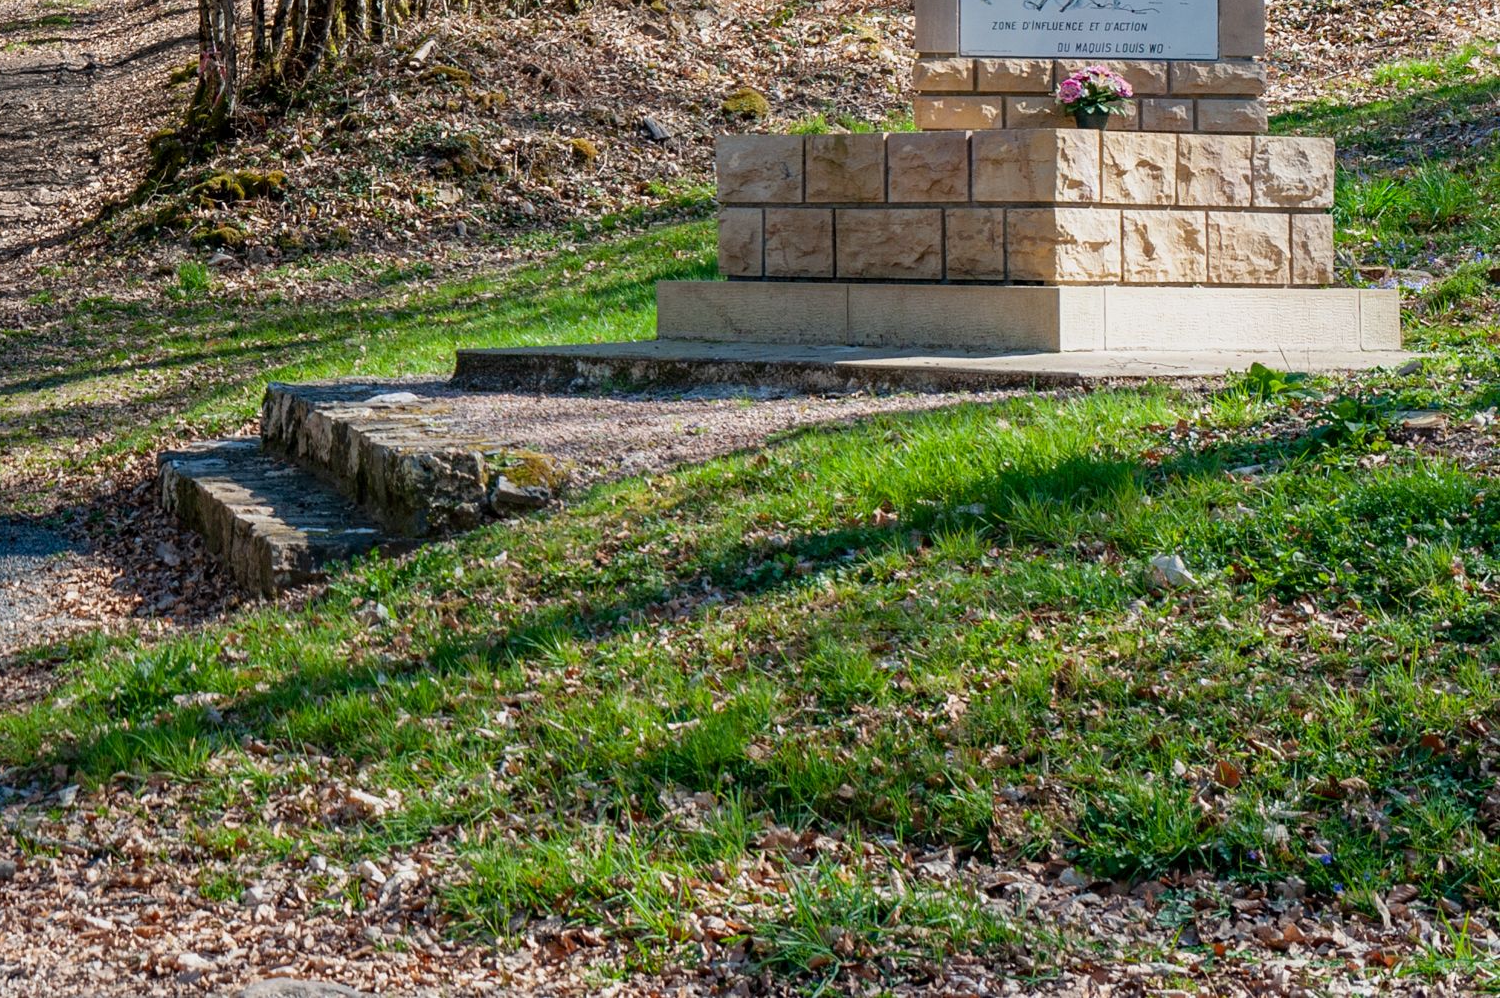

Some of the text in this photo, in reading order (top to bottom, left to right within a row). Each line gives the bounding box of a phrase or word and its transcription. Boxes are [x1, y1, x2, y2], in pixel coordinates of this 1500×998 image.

[992, 20, 1148, 32] ZONE D'INFLUENCE ET D'ACTION
[1057, 42, 1070, 52] DU
[1075, 42, 1112, 54] MAQUIS
[1115, 42, 1145, 53] LOUIS
